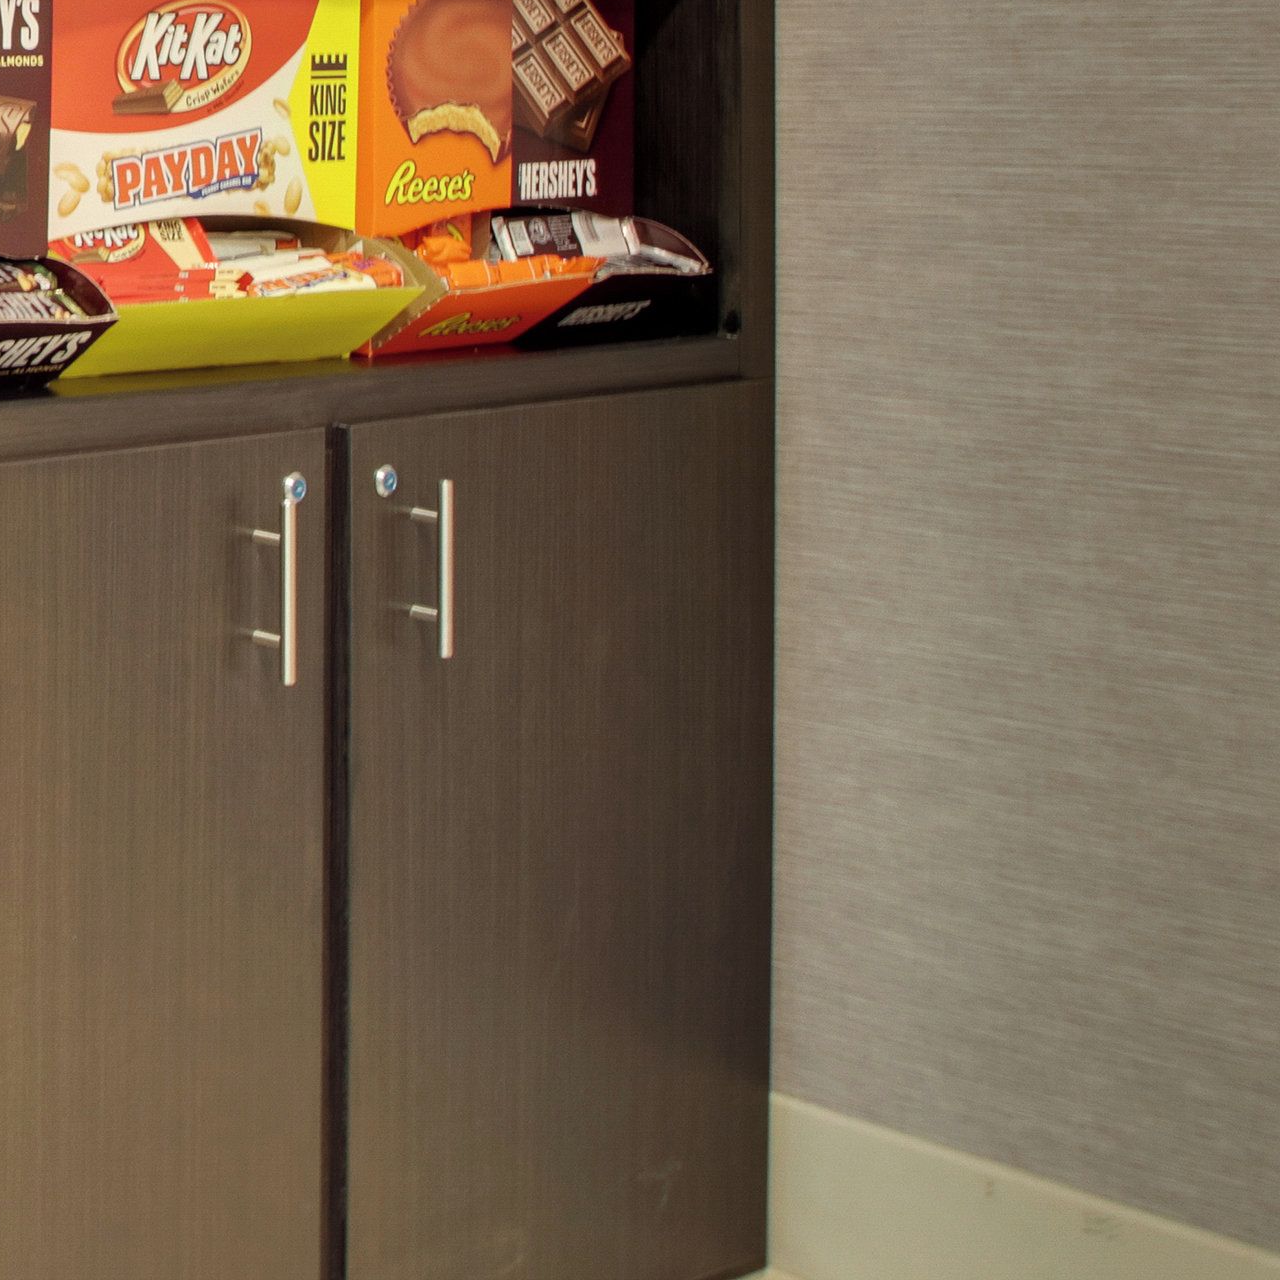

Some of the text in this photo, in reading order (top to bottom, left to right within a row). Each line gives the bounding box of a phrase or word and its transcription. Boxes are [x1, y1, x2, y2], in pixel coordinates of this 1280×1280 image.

[185, 90, 211, 108] Crisp
[211, 69, 240, 99] Wafers
[309, 83, 347, 116] KING
[308, 120, 347, 162] SIZE
[115, 133, 260, 204] PAYDAY
[385, 159, 476, 205] Reese's
[520, 158, 597, 201] HERSHEY'S
[160, 228, 185, 243] SIZE
[14, 364, 64, 375] ALMONDS
